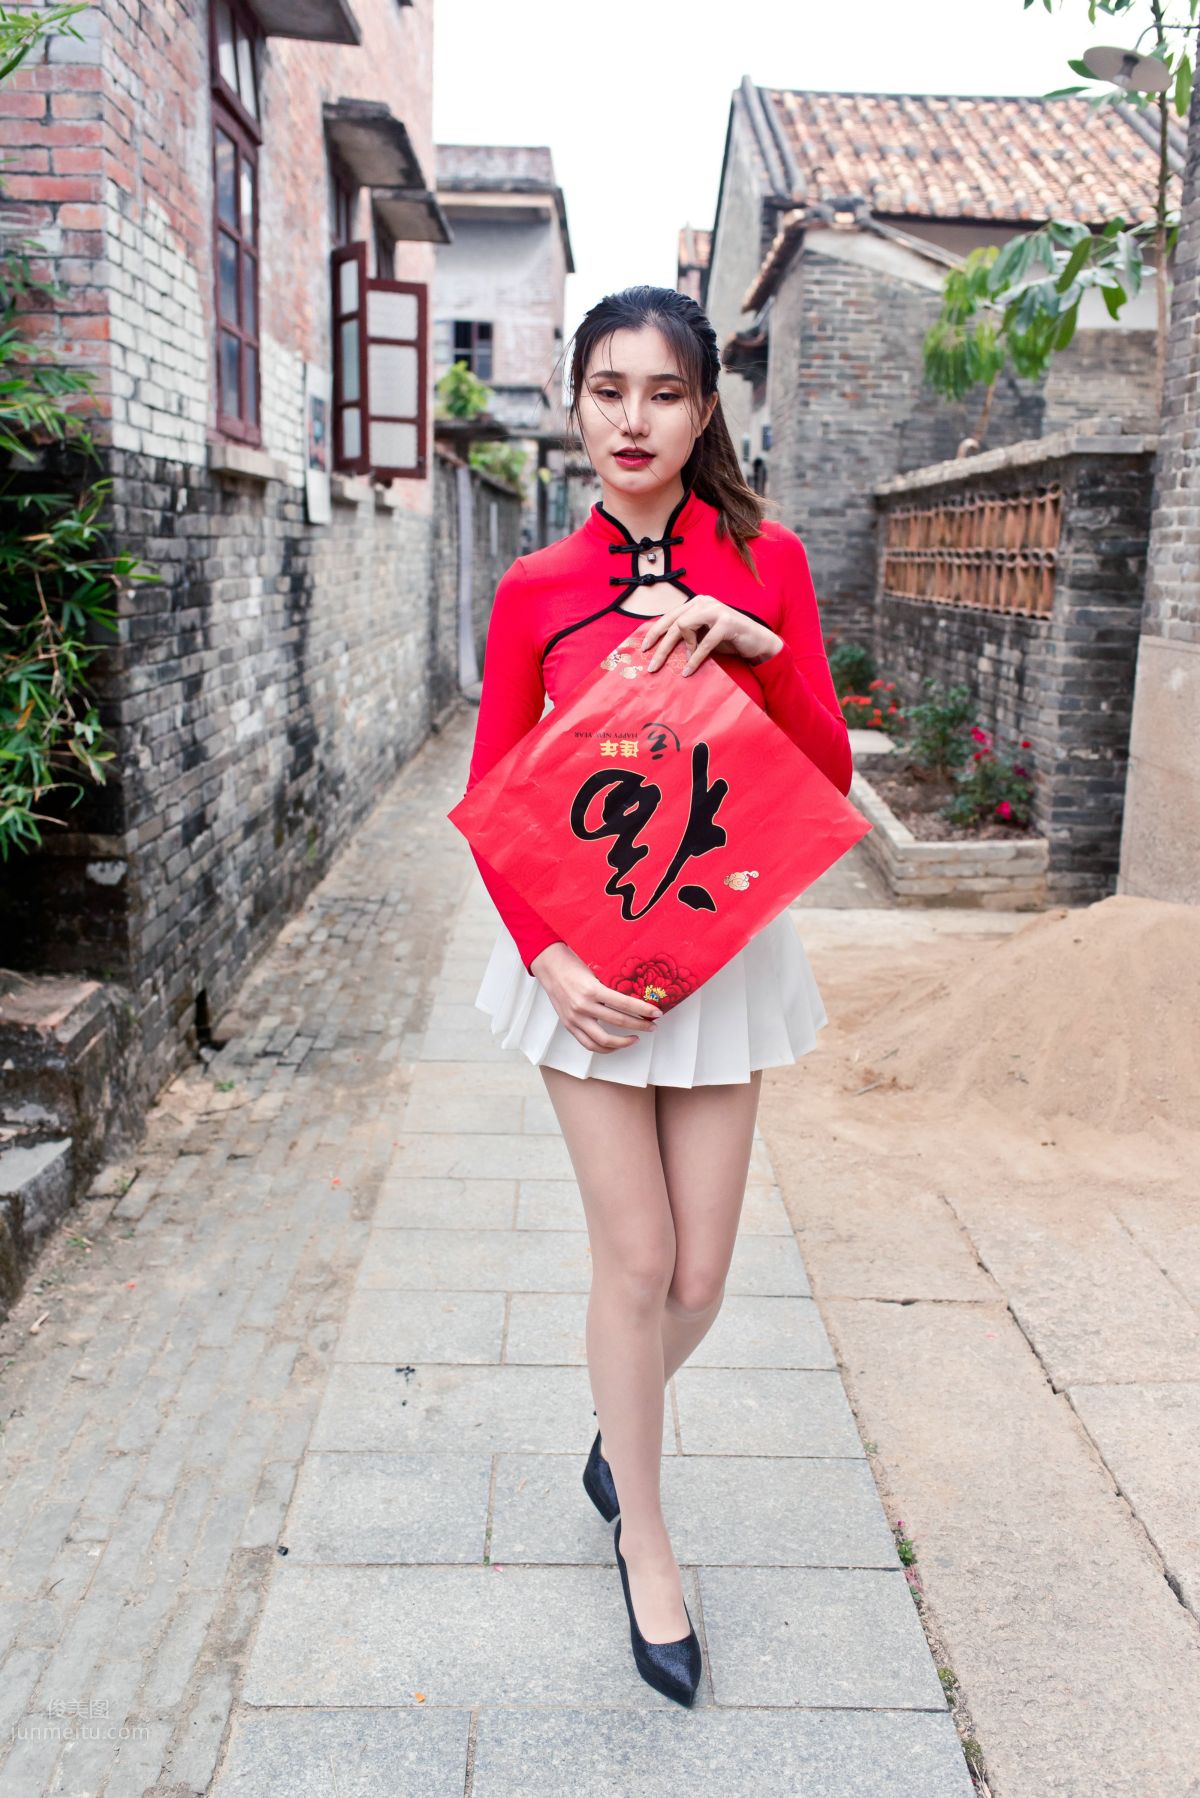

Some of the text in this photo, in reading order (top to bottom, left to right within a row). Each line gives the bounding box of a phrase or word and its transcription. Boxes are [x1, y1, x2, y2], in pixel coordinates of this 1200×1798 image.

[574, 731, 593, 739] YEAR
[614, 731, 638, 739] HAPPY
[570, 741, 730, 921] 福
